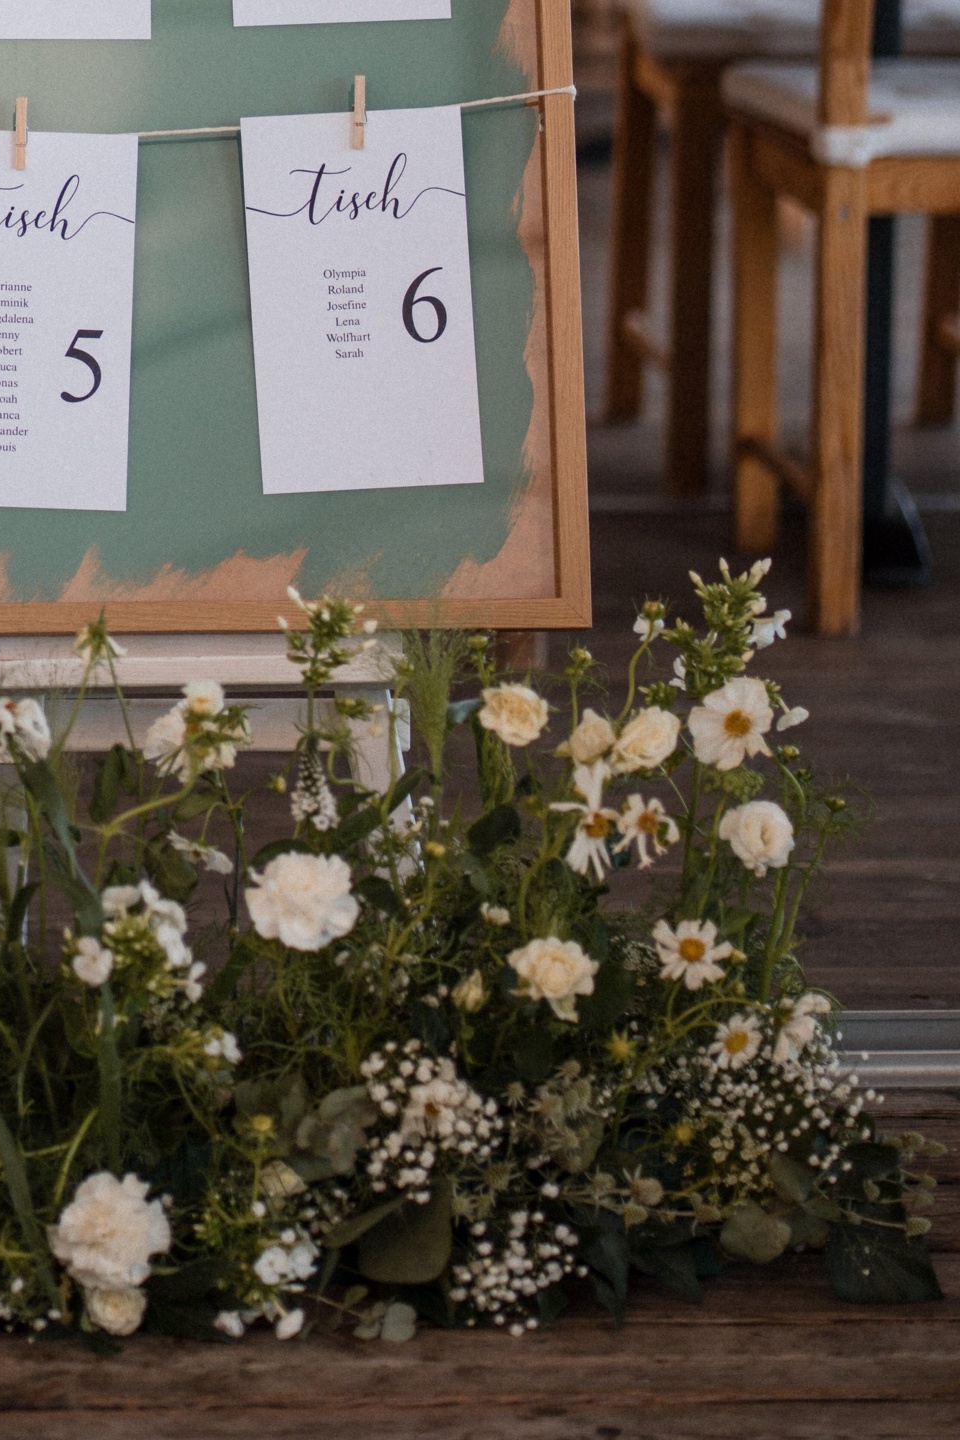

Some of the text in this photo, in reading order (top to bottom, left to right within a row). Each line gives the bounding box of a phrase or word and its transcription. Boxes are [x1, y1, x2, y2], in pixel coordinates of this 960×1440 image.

[322, 267, 367, 281] Olympia
[327, 283, 364, 295] Roland
[326, 299, 367, 312] Josefine
[402, 267, 447, 343] 6
[335, 317, 361, 327] Lena
[326, 332, 371, 343] Wolfhart
[335, 347, 364, 359] Sarah
[61, 329, 103, 403] 5
